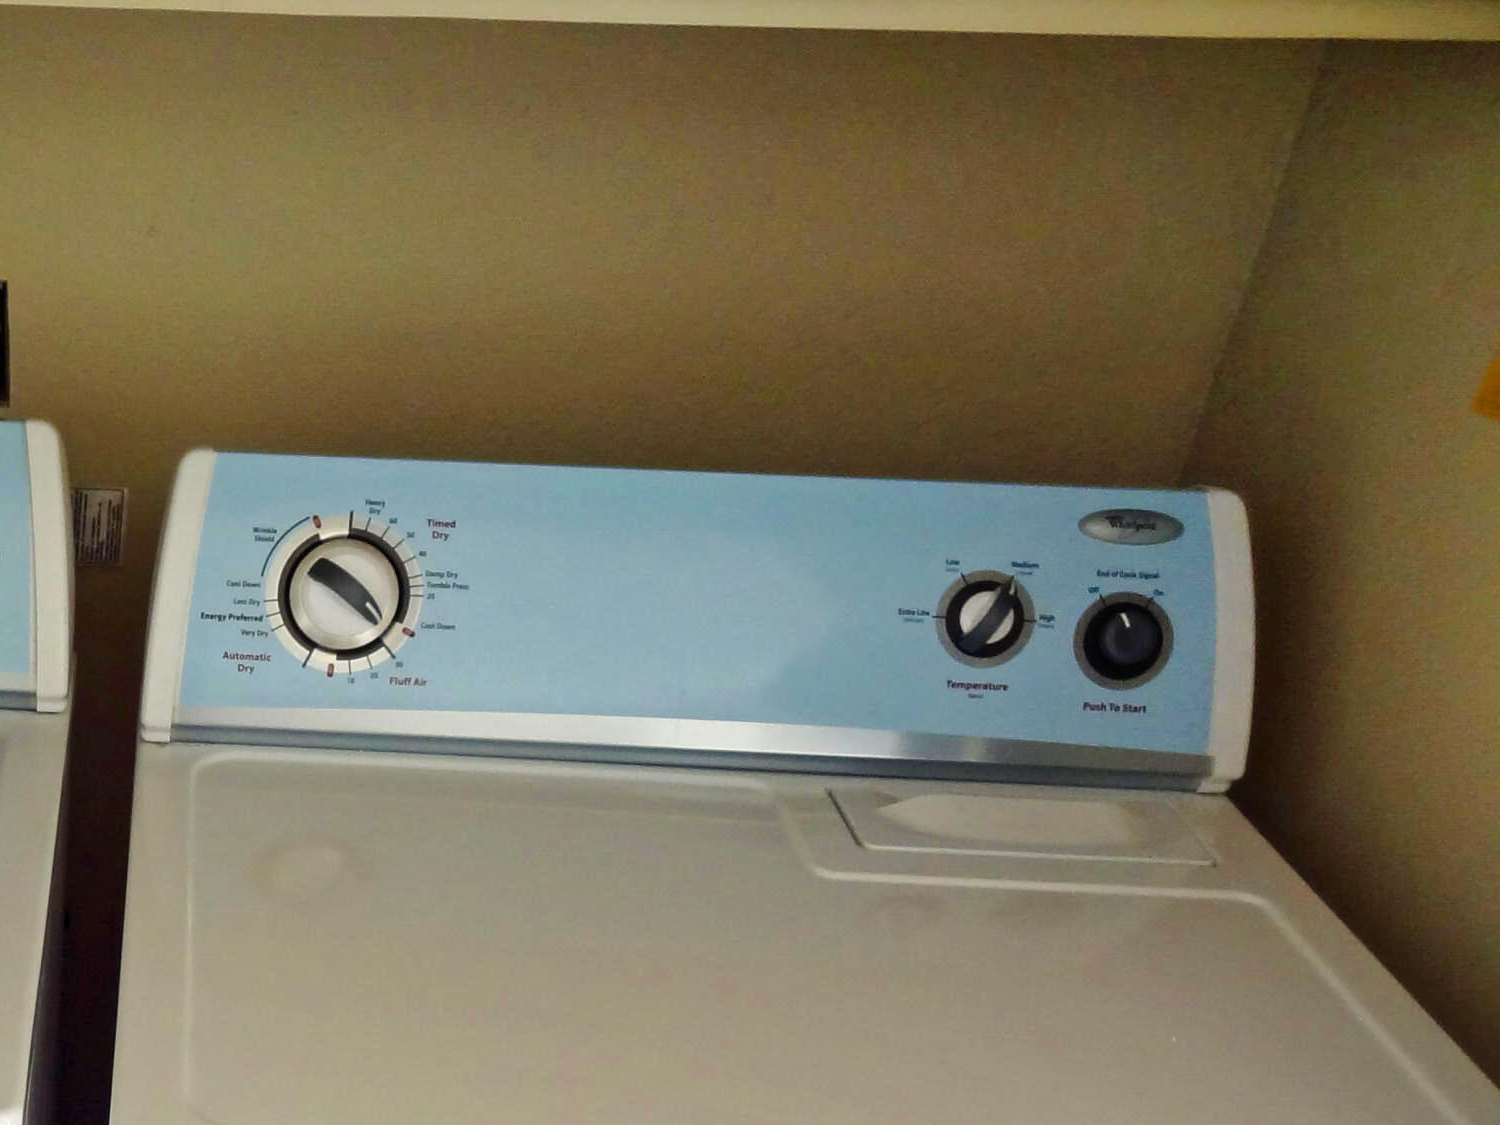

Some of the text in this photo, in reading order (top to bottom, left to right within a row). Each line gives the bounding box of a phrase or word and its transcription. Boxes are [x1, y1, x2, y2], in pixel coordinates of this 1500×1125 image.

[426, 518, 457, 530] Timed
[431, 530, 451, 543] Dry
[945, 558, 961, 567] Low
[1011, 560, 1041, 570] Medium
[446, 570, 459, 579] Dry
[248, 598, 261, 608] Dry
[200, 611, 264, 623] Energy Preferred
[1038, 612, 1056, 623] High
[240, 628, 269, 638] Very Dry
[222, 651, 273, 662] Automatic
[237, 663, 255, 675] Dry
[389, 676, 428, 687] Fluff Air
[946, 680, 1009, 692] Temperature
[1083, 701, 1148, 714] Push To Start
